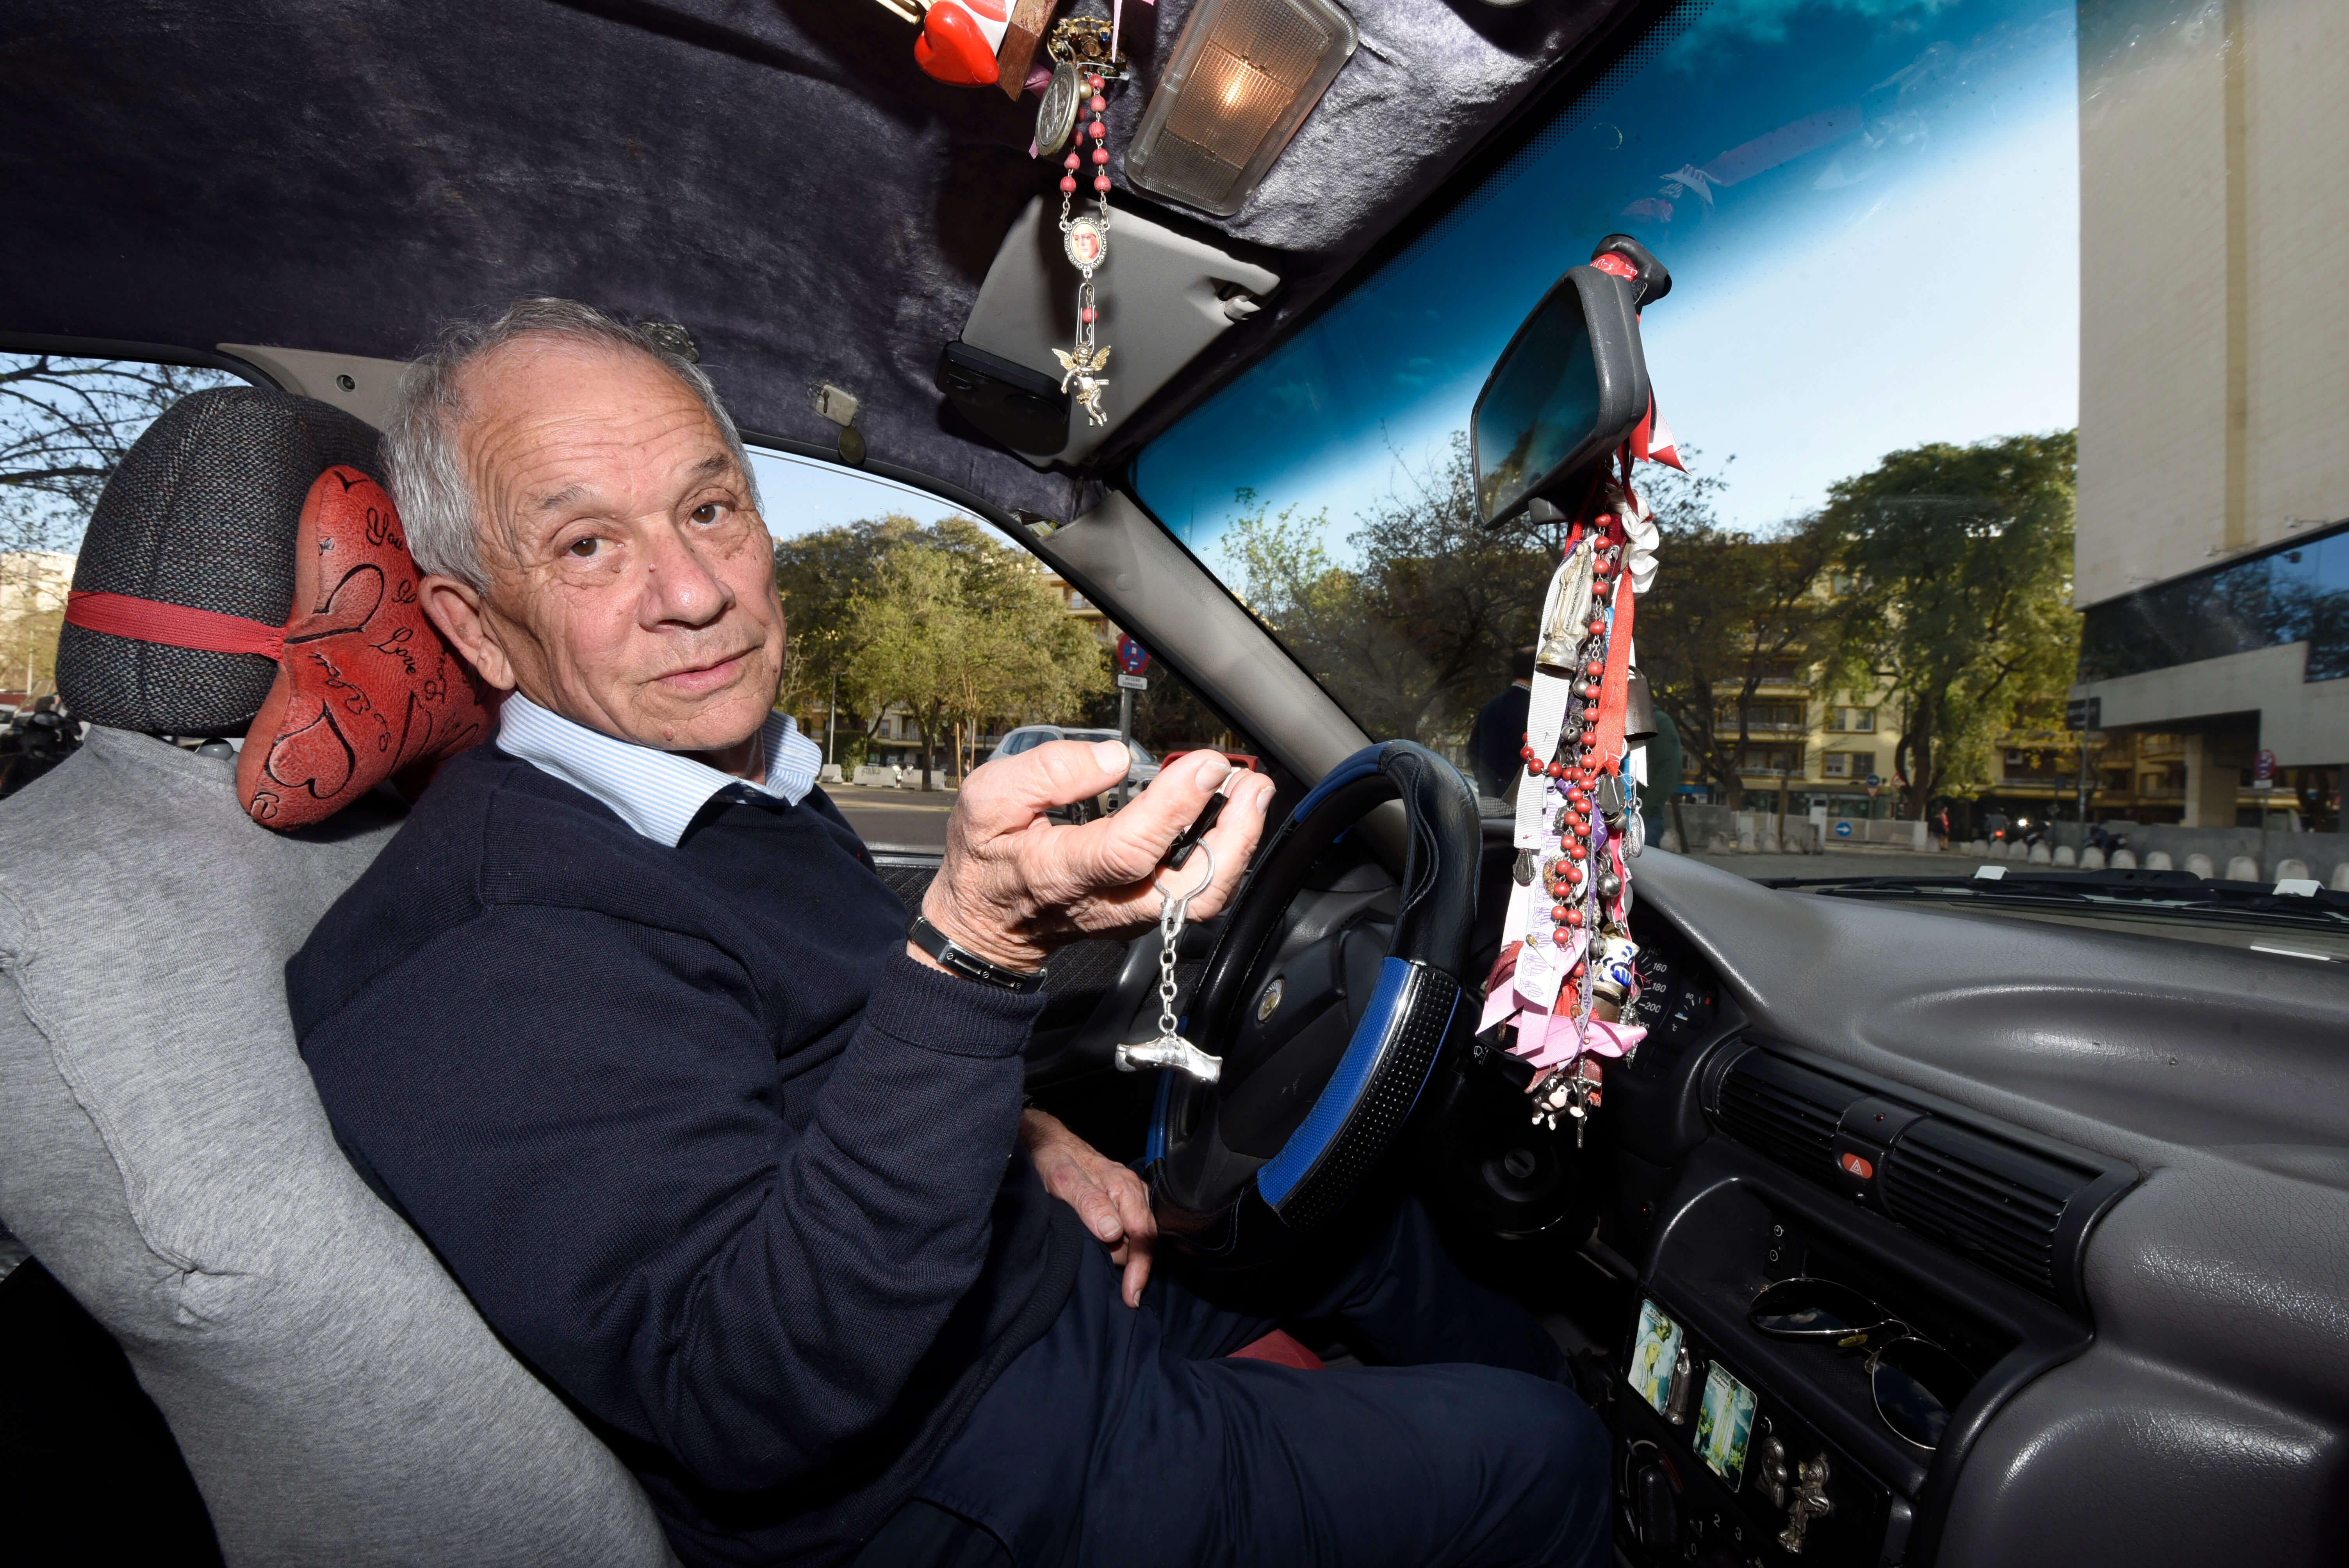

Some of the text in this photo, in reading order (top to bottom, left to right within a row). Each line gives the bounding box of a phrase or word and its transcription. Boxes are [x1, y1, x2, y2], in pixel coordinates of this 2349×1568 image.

[366, 508, 403, 551] You
[368, 627, 416, 675] Love
[1653, 962, 1667, 973] 160
[1653, 983, 1666, 992] 180
[1645, 1002, 1661, 1013] 200
[1698, 1521, 1703, 1533] 1
[1713, 1513, 1720, 1528] 2
[1735, 1526, 1742, 1541] 3
[1691, 1543, 1697, 1556] 0
